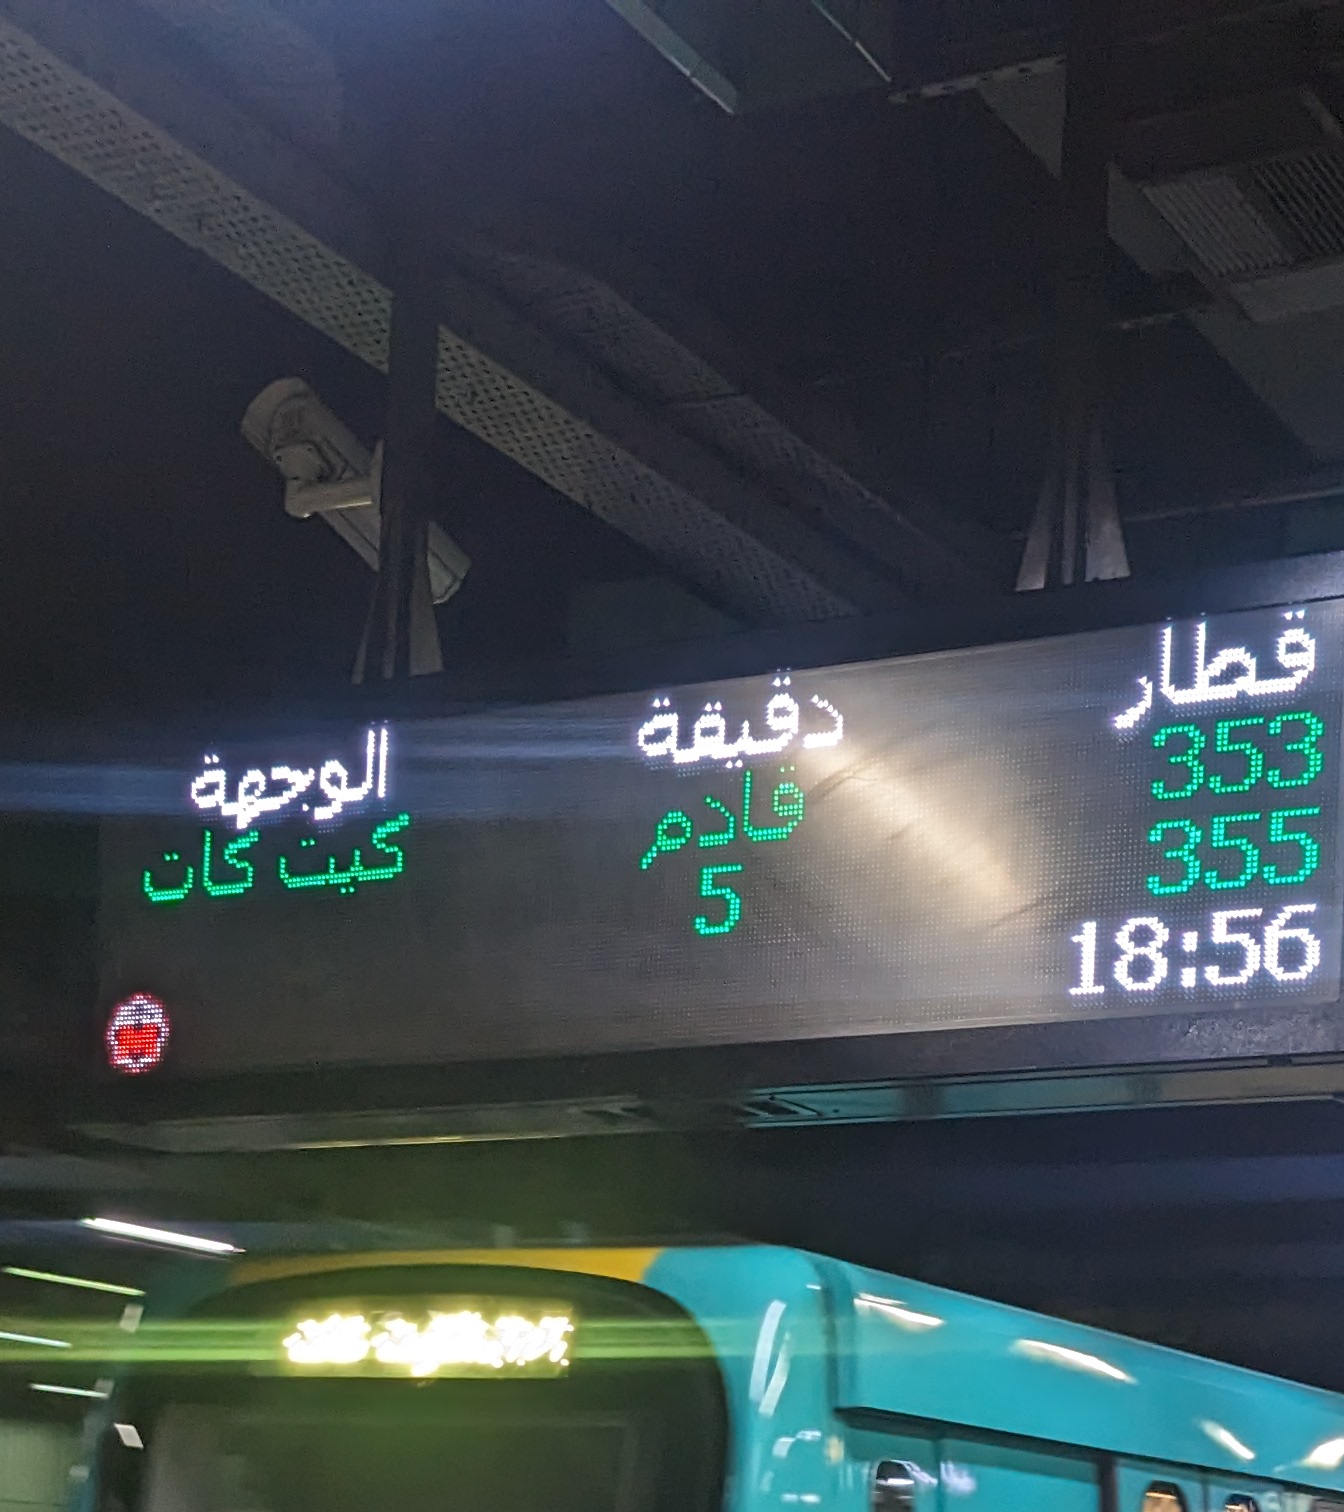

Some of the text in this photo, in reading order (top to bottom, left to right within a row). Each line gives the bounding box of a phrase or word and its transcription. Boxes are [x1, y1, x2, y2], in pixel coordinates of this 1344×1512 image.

[191, 611, 1317, 829] قطار دقيقة الوجهة
[1152, 711, 1324, 799] 353
[142, 766, 805, 903] قادم كيت كات
[693, 806, 1321, 936] 355 5
[1069, 903, 1321, 996] 18:56
